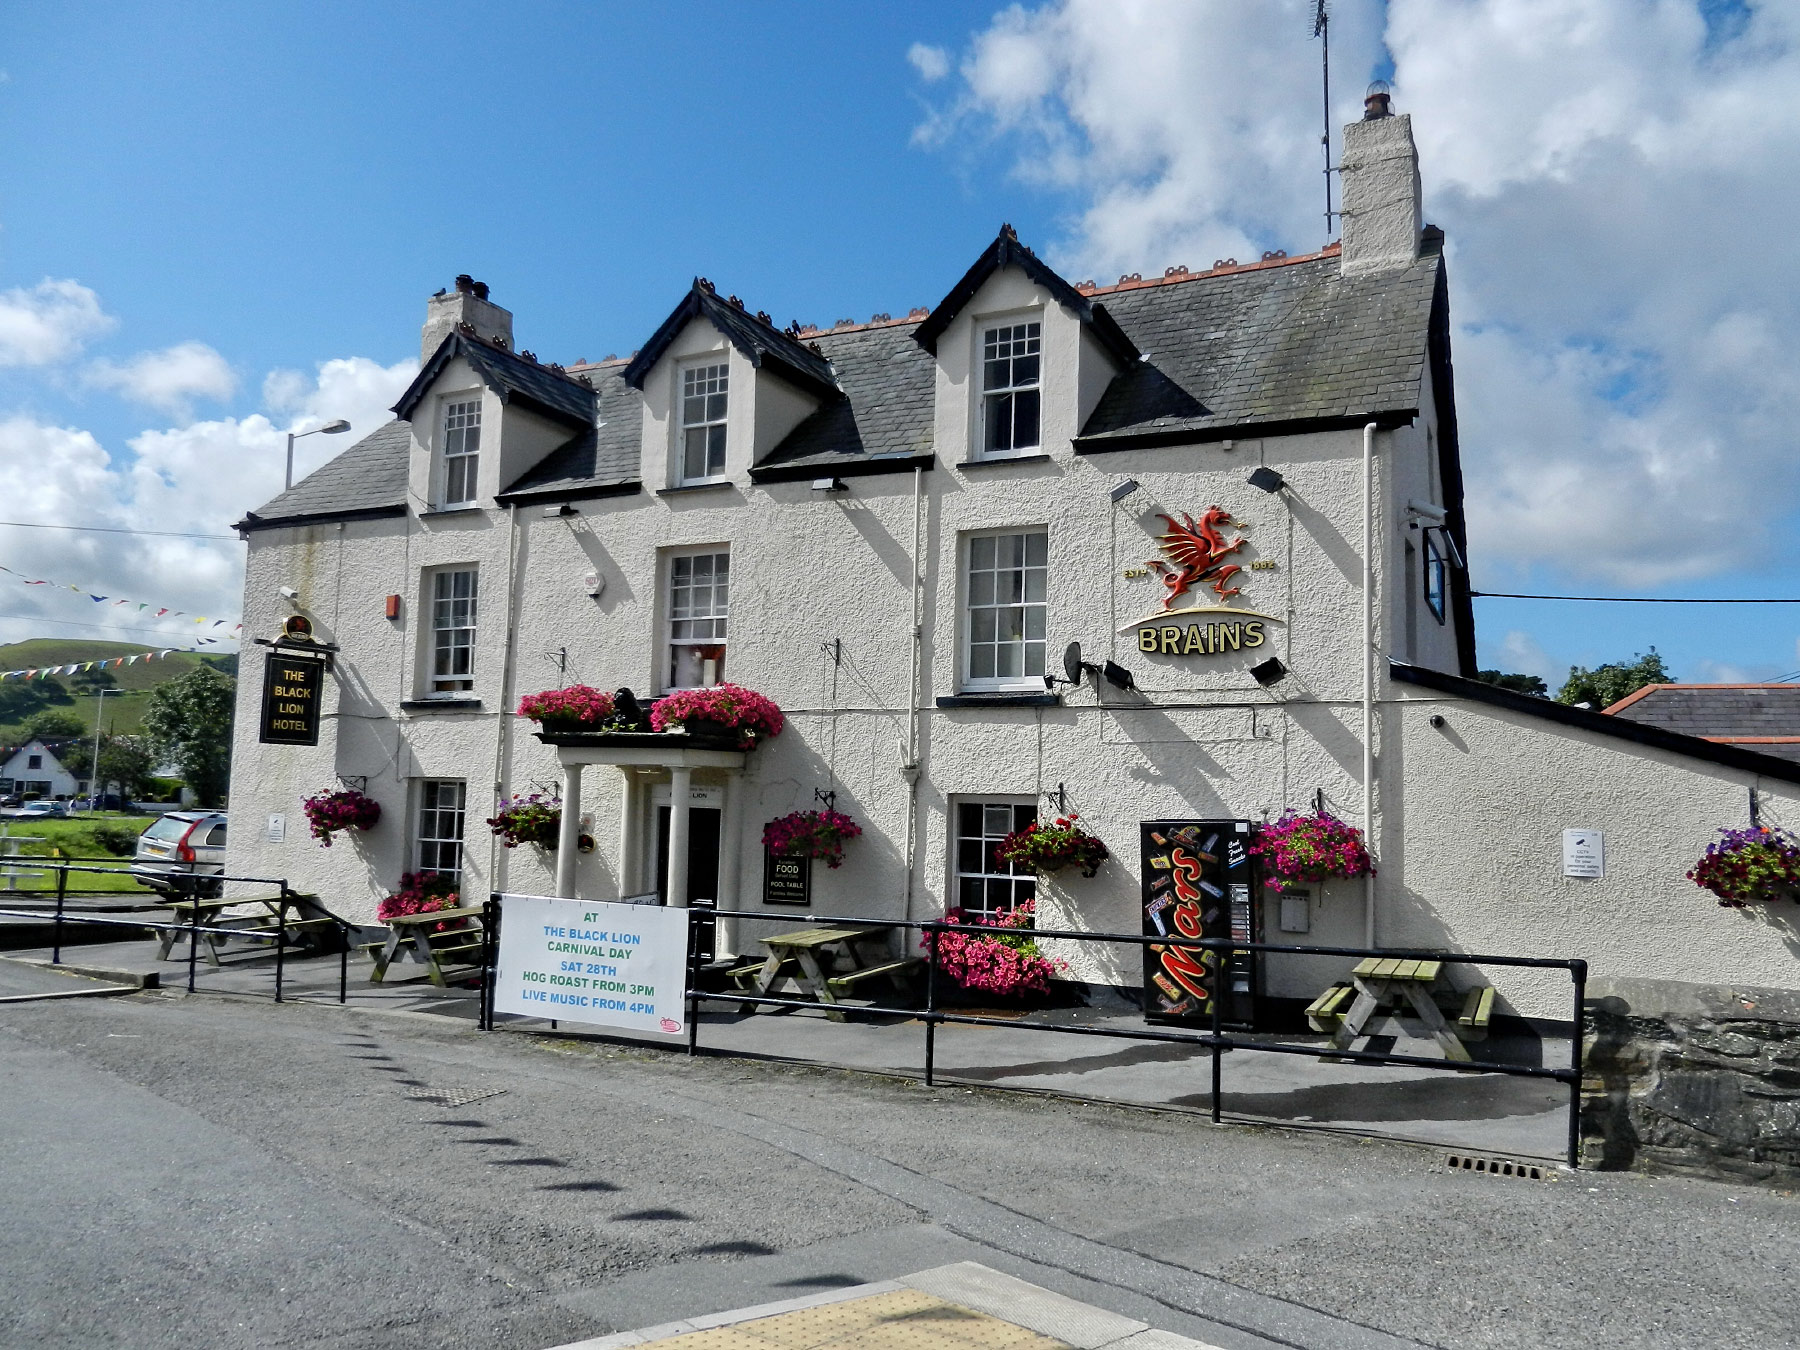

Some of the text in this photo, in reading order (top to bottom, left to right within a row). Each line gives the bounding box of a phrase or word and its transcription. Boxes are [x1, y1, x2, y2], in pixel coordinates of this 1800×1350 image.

[1138, 620, 1266, 656] BRAINS
[284, 670, 305, 682] THE
[274, 686, 311, 698] BLACK
[280, 703, 304, 714] LION
[273, 720, 308, 731] HOTEL
[776, 864, 799, 873] FOOD
[584, 912, 599, 922] AT
[1161, 847, 1209, 999] Mars
[543, 926, 640, 945] THE BLACK LION
[547, 941, 632, 959] CARNIVAL DAY
[561, 960, 617, 976] SAT 28TH
[522, 971, 655, 997] HOG ROAST FROM 3PM
[522, 989, 655, 1015] LIVE MUSIC FROM 4PM
